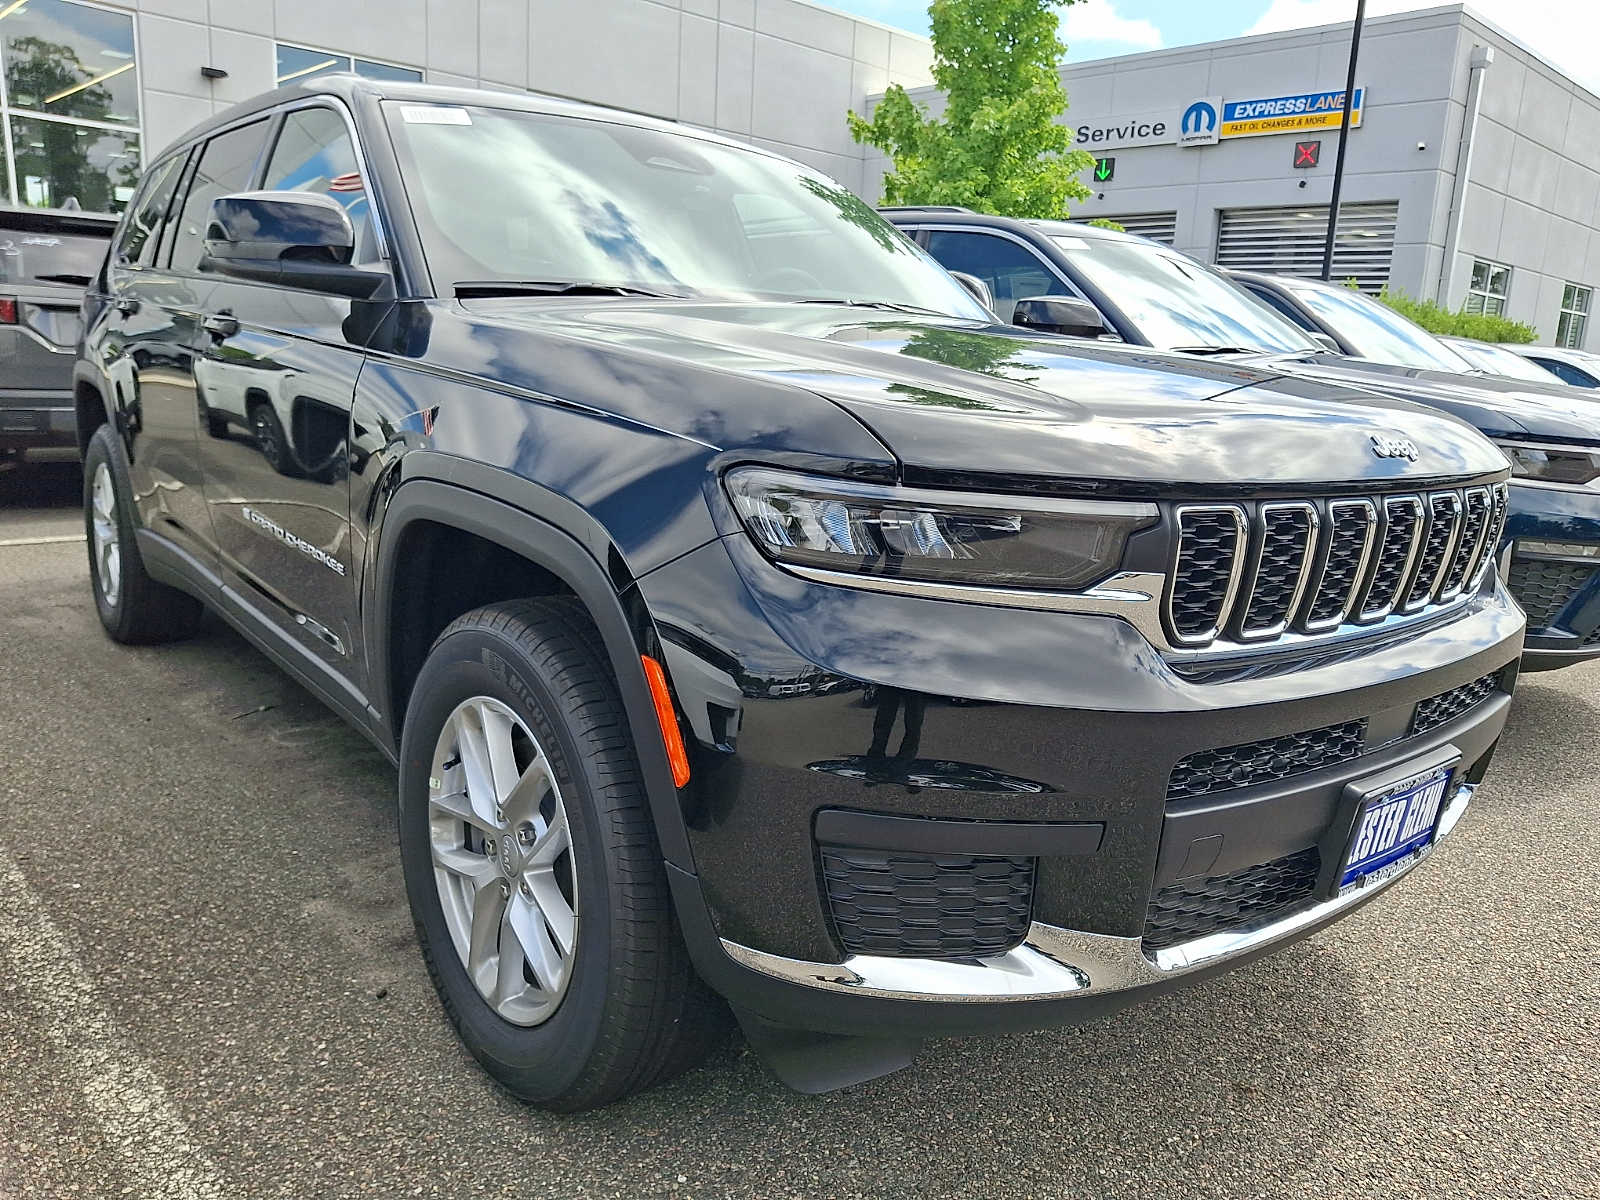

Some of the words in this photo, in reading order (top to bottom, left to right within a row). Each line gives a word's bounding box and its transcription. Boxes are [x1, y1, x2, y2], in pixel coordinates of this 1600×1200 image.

[1076, 121, 1166, 143] Service
[1369, 433, 1419, 462] Jeep
[284, 529, 346, 577] CHEROKEE
[508, 674, 572, 784] MICHELIN
